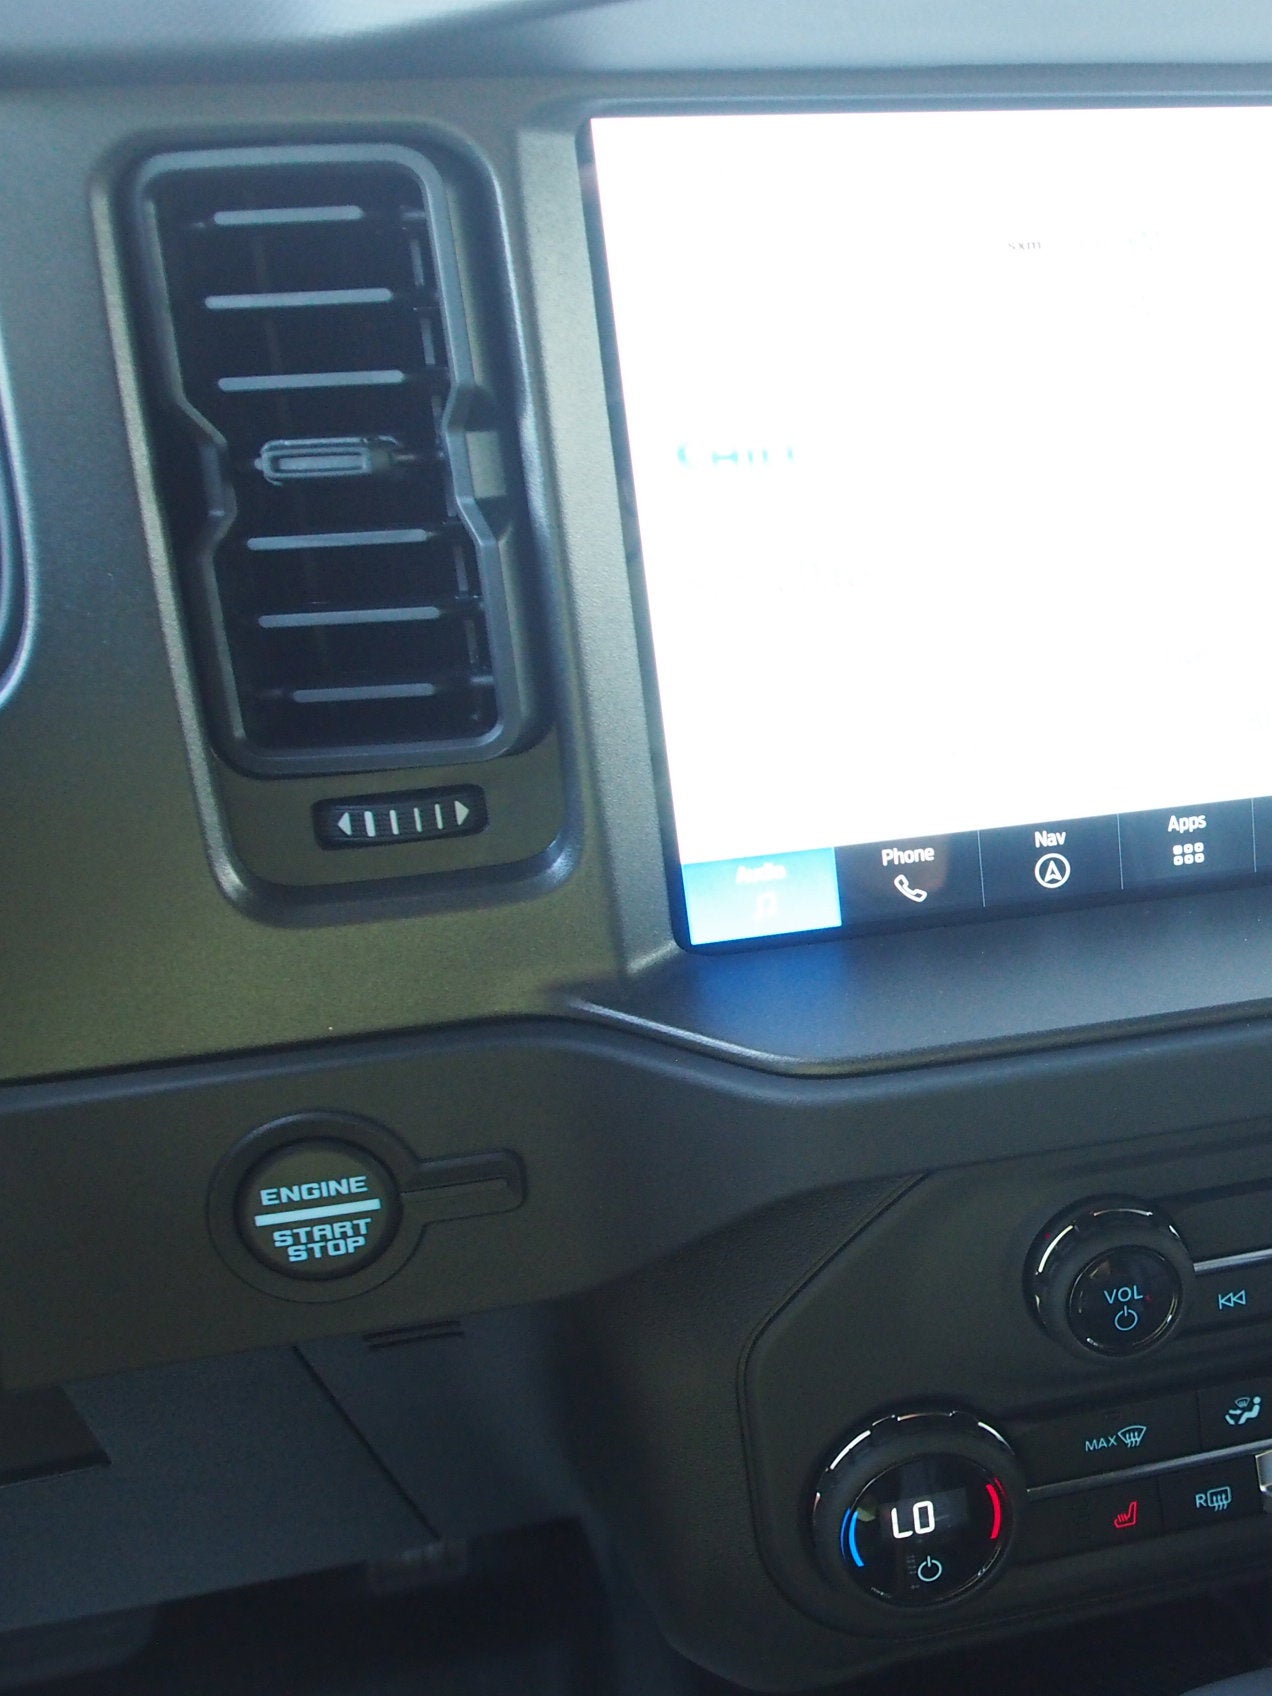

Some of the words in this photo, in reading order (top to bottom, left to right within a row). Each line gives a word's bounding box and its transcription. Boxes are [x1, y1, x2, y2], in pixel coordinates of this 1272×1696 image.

[1168, 814, 1207, 834] Apps
[1034, 830, 1067, 849] Nav
[881, 846, 935, 867] Phone
[260, 1176, 368, 1206] ENGINE
[273, 1218, 371, 1247] START
[287, 1236, 366, 1262] STOP
[1104, 1288, 1143, 1305] VOL
[1085, 1435, 1118, 1452] MAX
[1195, 1493, 1206, 1508] R
[891, 1501, 936, 1539] LO
